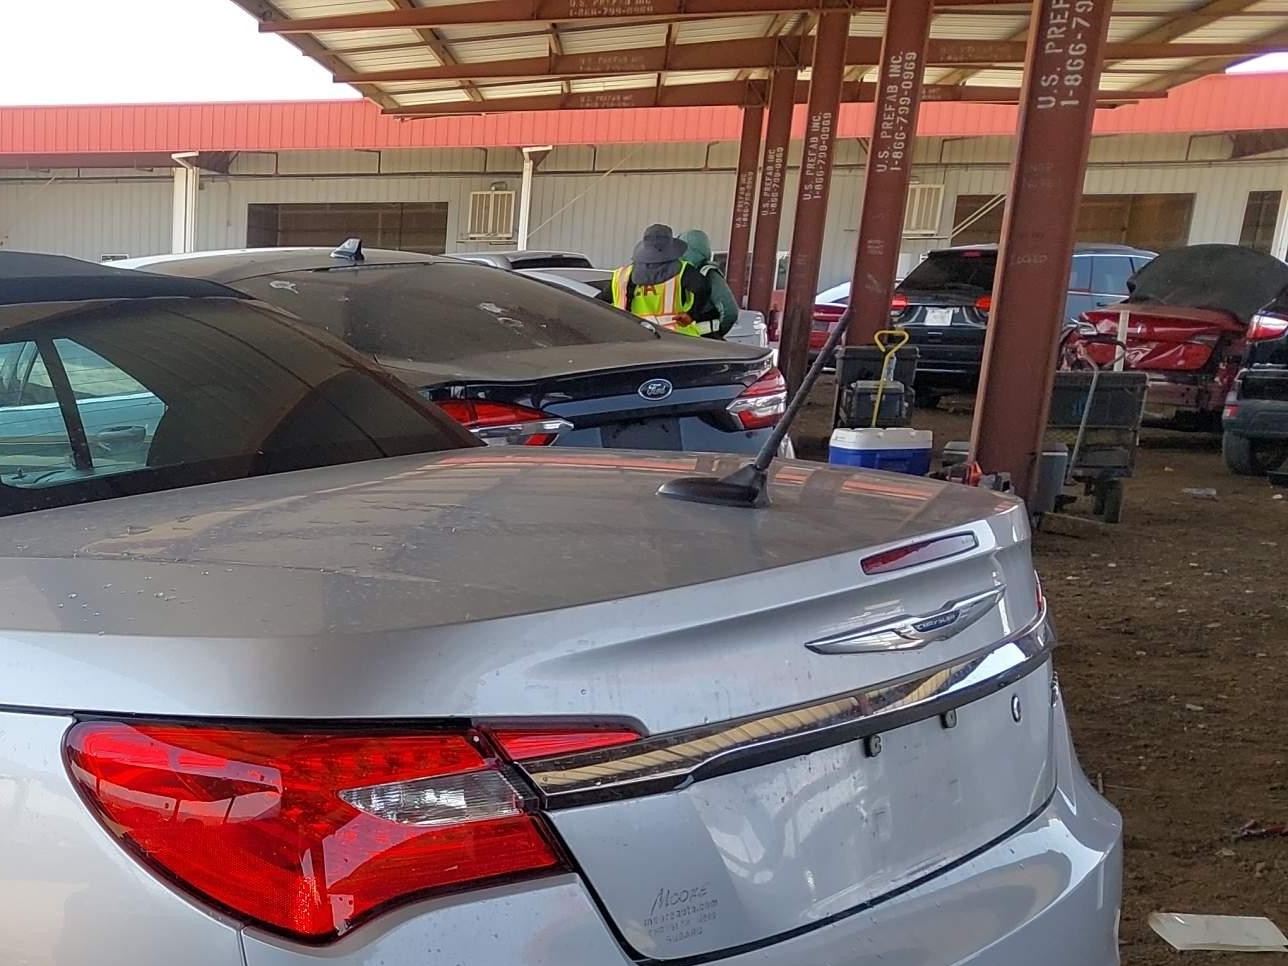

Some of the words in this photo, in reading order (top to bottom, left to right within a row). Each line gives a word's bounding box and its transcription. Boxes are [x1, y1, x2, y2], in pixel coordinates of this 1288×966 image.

[888, 50, 904, 78] INC.
[1037, 66, 1061, 109] U.S.
[880, 84, 899, 139] PREFAB
[889, 51, 918, 171] 1-866-799-0969
[875, 146, 891, 173] U.S.
